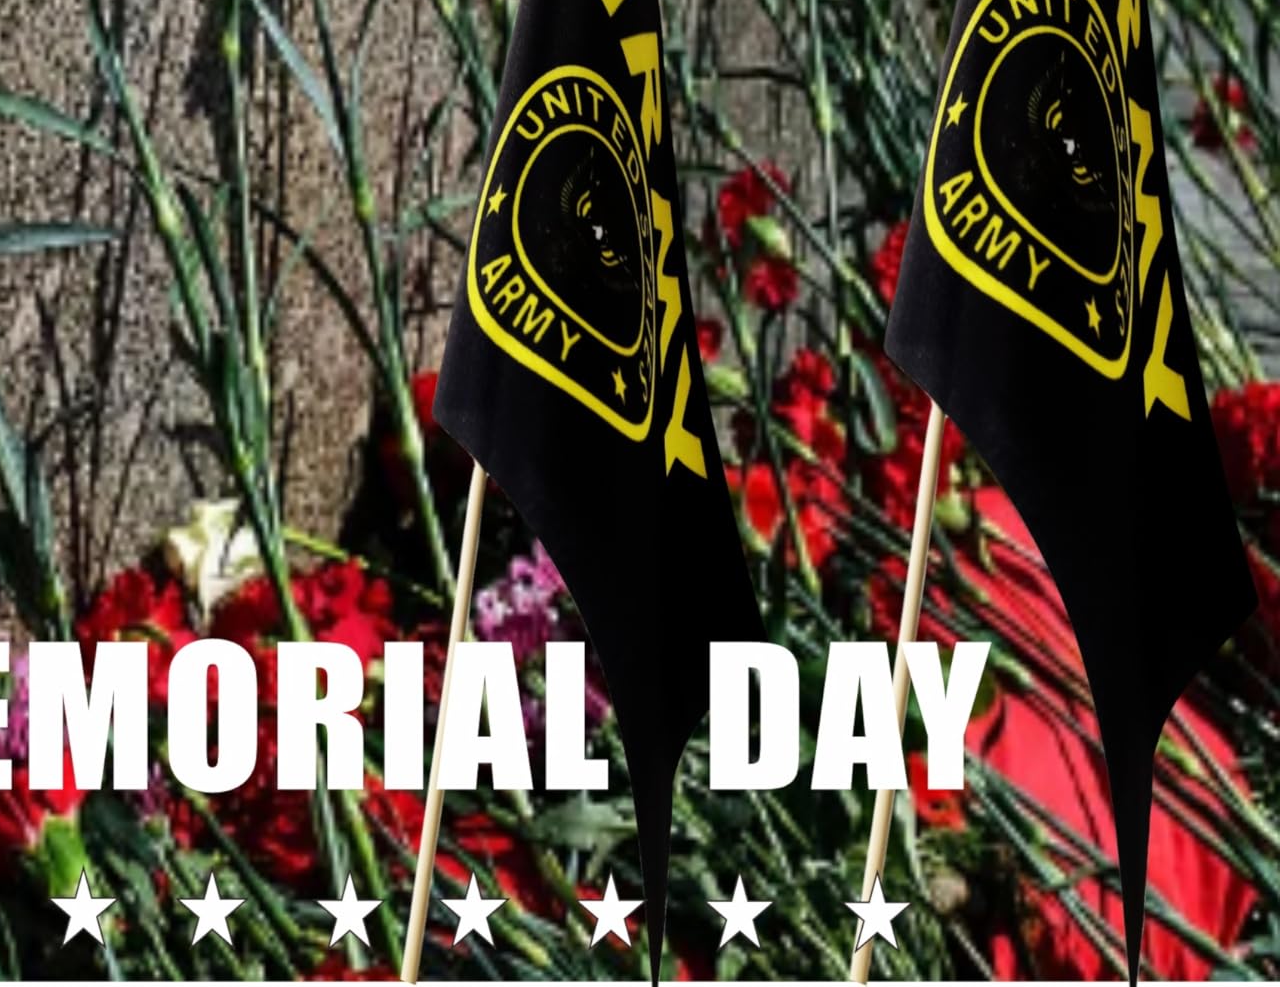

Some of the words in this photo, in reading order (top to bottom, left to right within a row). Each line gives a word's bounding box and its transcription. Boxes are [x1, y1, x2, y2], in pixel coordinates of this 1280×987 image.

[516, 84, 642, 185] UNITED
[939, 171, 1052, 292] ARMY
[481, 255, 582, 362] ARMY
